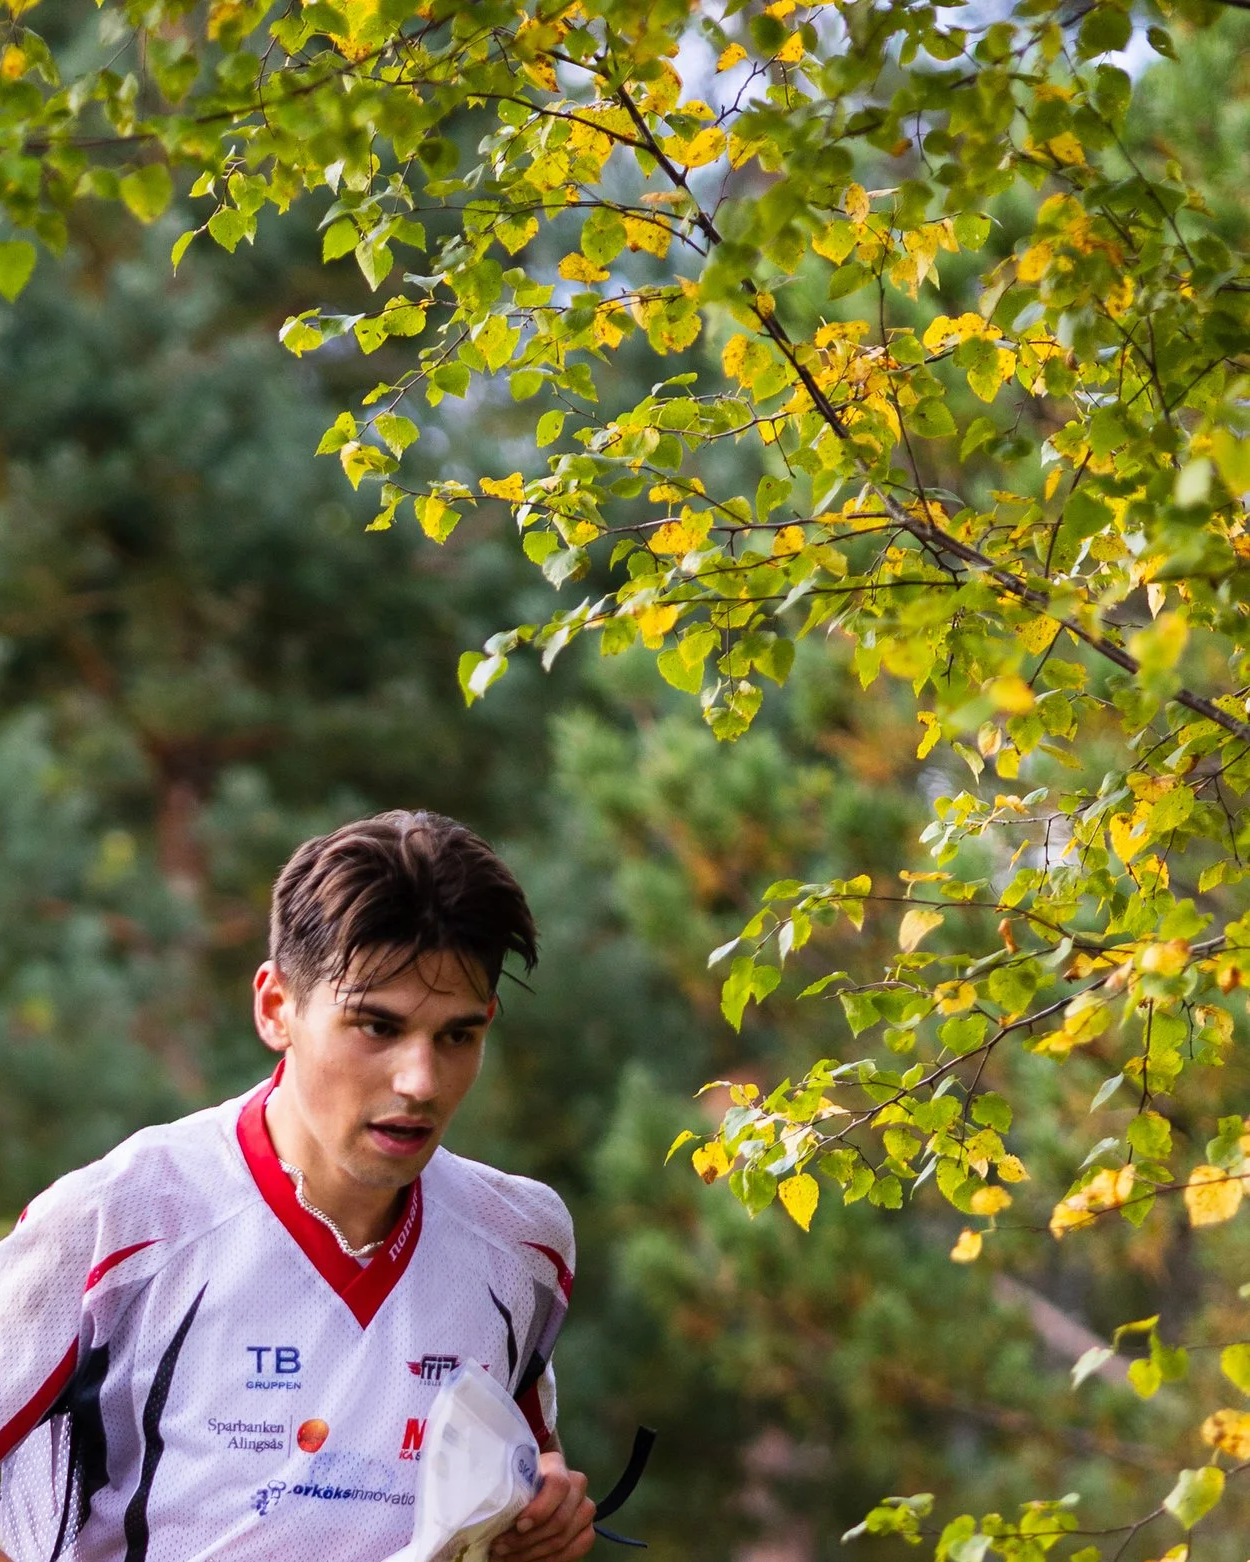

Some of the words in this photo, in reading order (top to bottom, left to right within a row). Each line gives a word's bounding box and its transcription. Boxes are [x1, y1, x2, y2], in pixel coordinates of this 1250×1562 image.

[246, 1346, 302, 1374] TB
[246, 1381, 302, 1390] GRUPPEN
[208, 1418, 285, 1435] Sparbanken
[227, 1436, 284, 1453] Alingsås
[286, 1484, 416, 1506] orköksinnovatio
